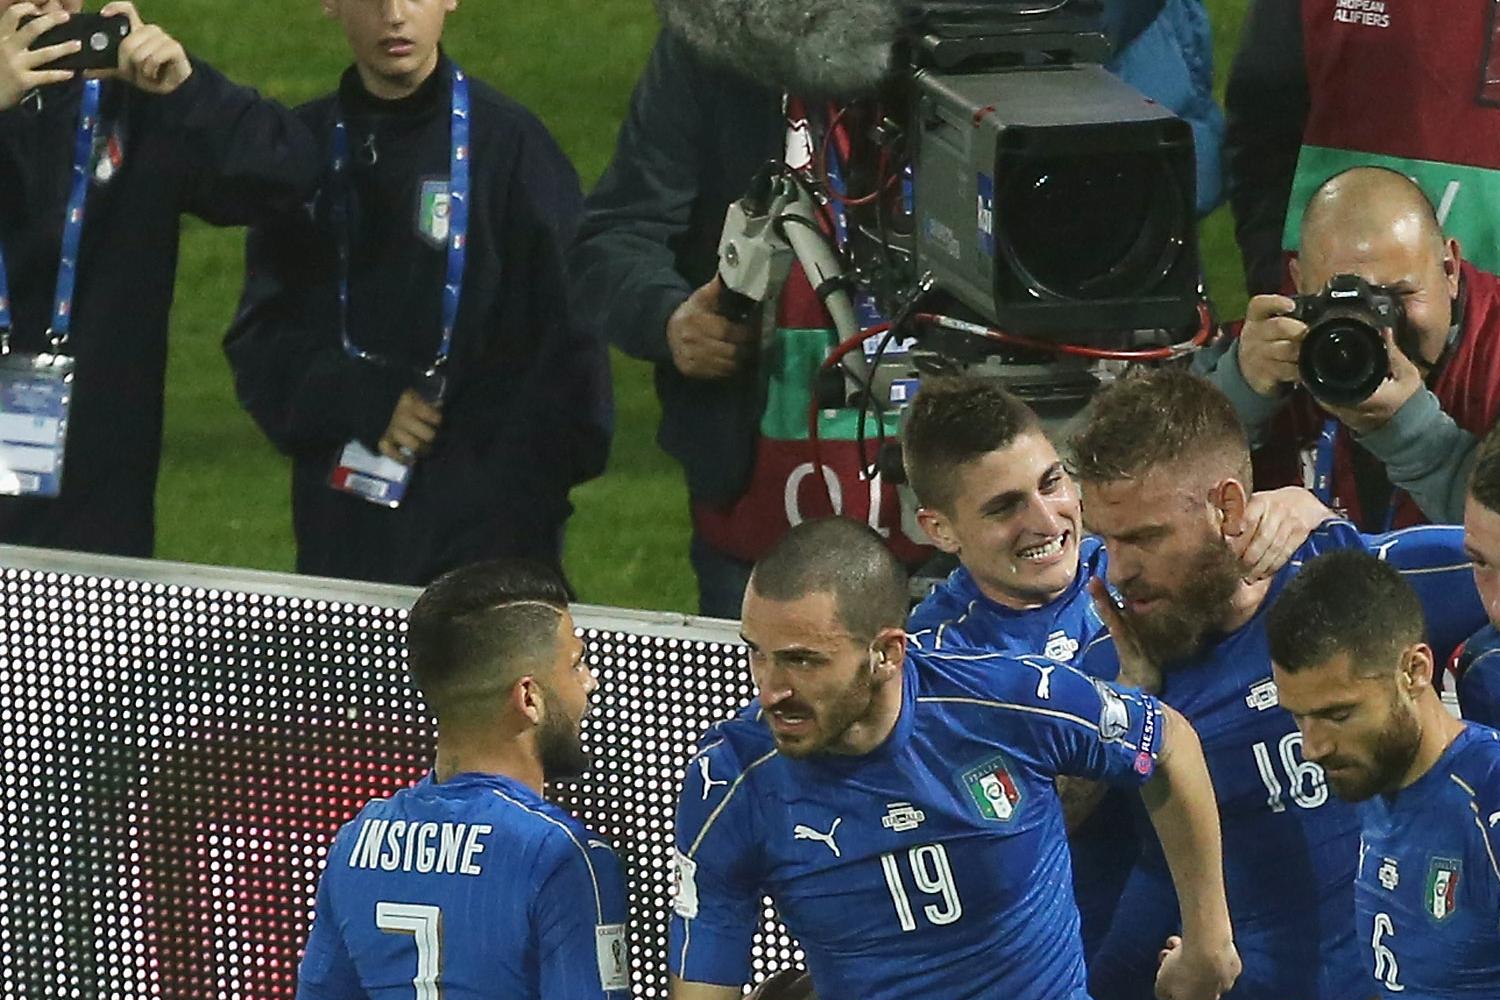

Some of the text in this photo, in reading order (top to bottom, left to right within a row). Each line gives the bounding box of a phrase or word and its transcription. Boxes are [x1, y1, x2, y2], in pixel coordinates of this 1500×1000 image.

[1333, 9, 1390, 28] ALIFIERS
[1252, 731, 1329, 813] 16
[348, 819, 493, 876] INSIGNE
[880, 842, 964, 932] 19
[1372, 912, 1405, 992] 6
